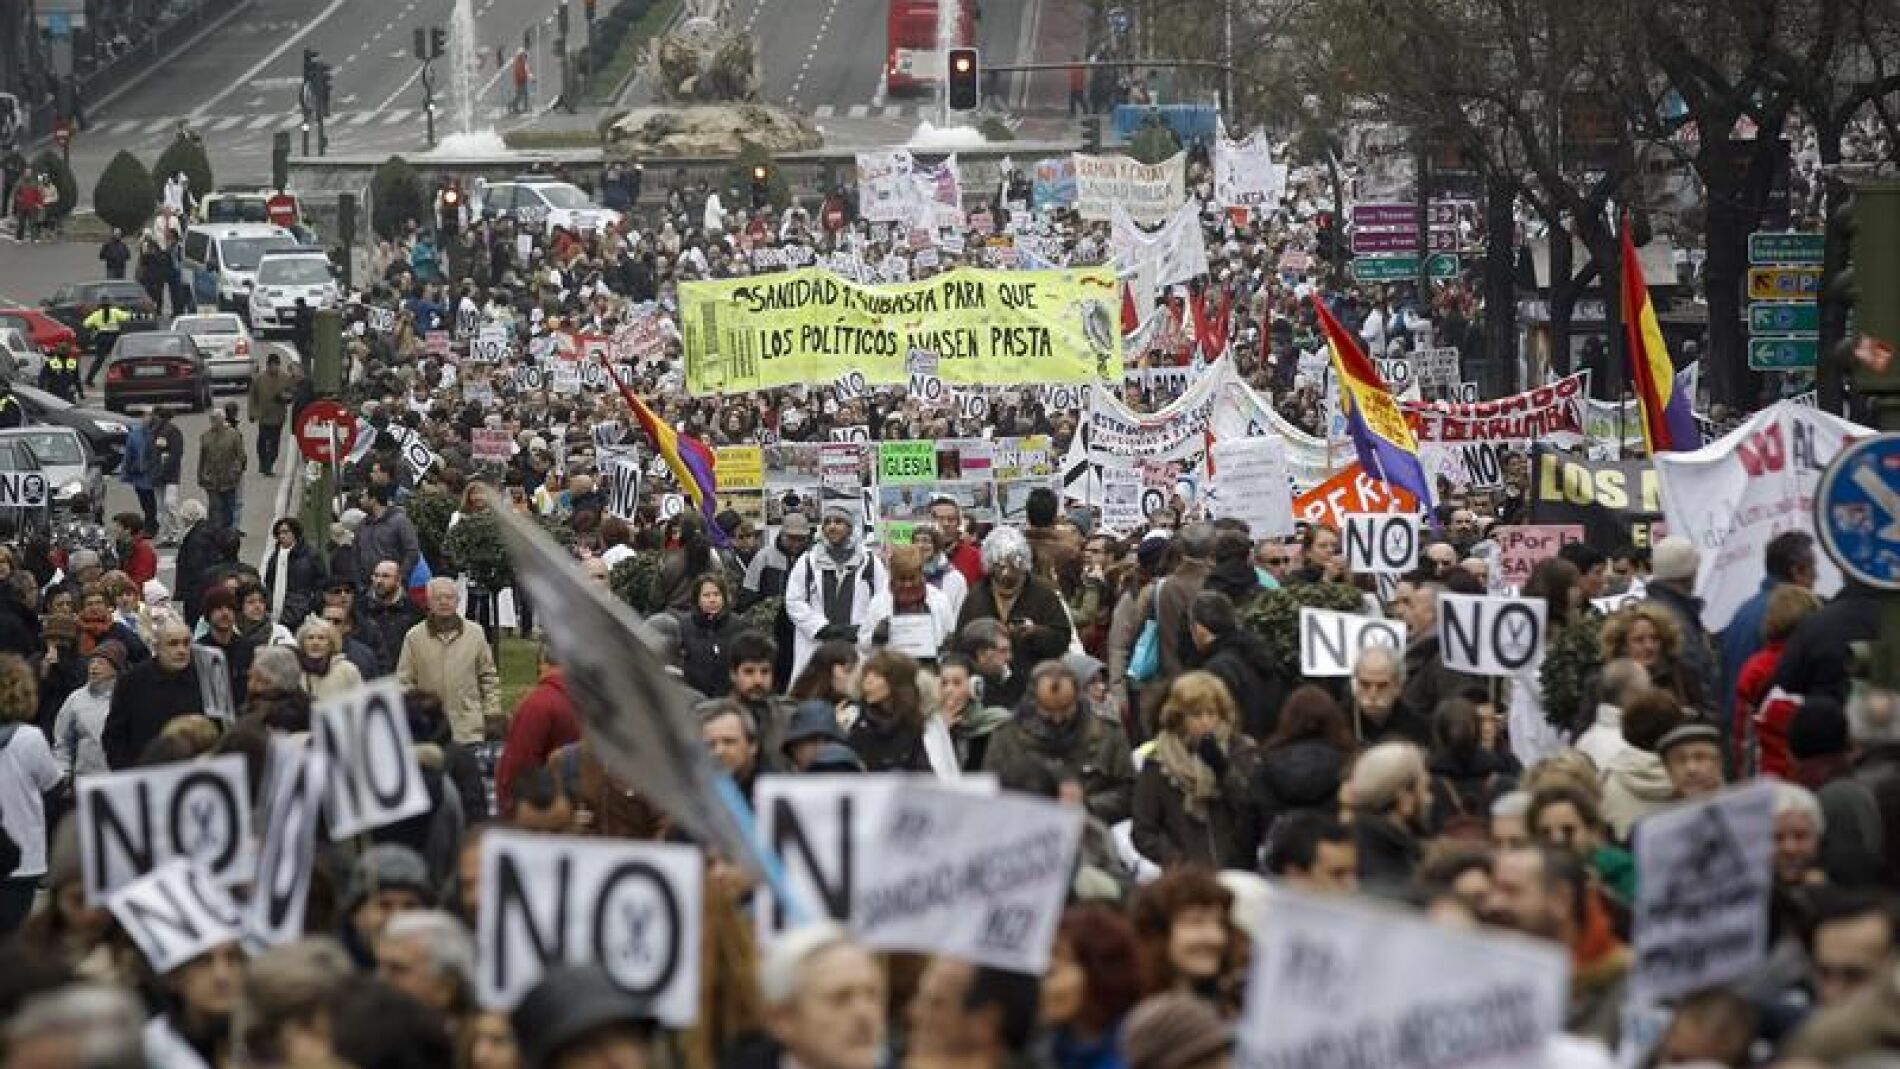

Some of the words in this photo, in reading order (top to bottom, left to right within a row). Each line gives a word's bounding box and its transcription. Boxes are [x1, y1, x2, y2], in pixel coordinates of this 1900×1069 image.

[748, 279, 838, 313] SANIDAD
[943, 280, 986, 309] PARA
[998, 282, 1038, 309] QUE
[760, 328, 794, 359] LOS
[801, 316, 897, 356] POLÍTICOS
[991, 327, 1052, 357] PASTA
[909, 374, 941, 399] NO
[884, 456, 933, 477] IGLESIA
[1540, 453, 1629, 509] LOS
[1345, 515, 1413, 569] NO
[1304, 611, 1400, 669] NO
[1442, 598, 1541, 670] NO
[321, 694, 407, 826] NO
[91, 770, 241, 895] NO
[494, 850, 683, 998] NO
